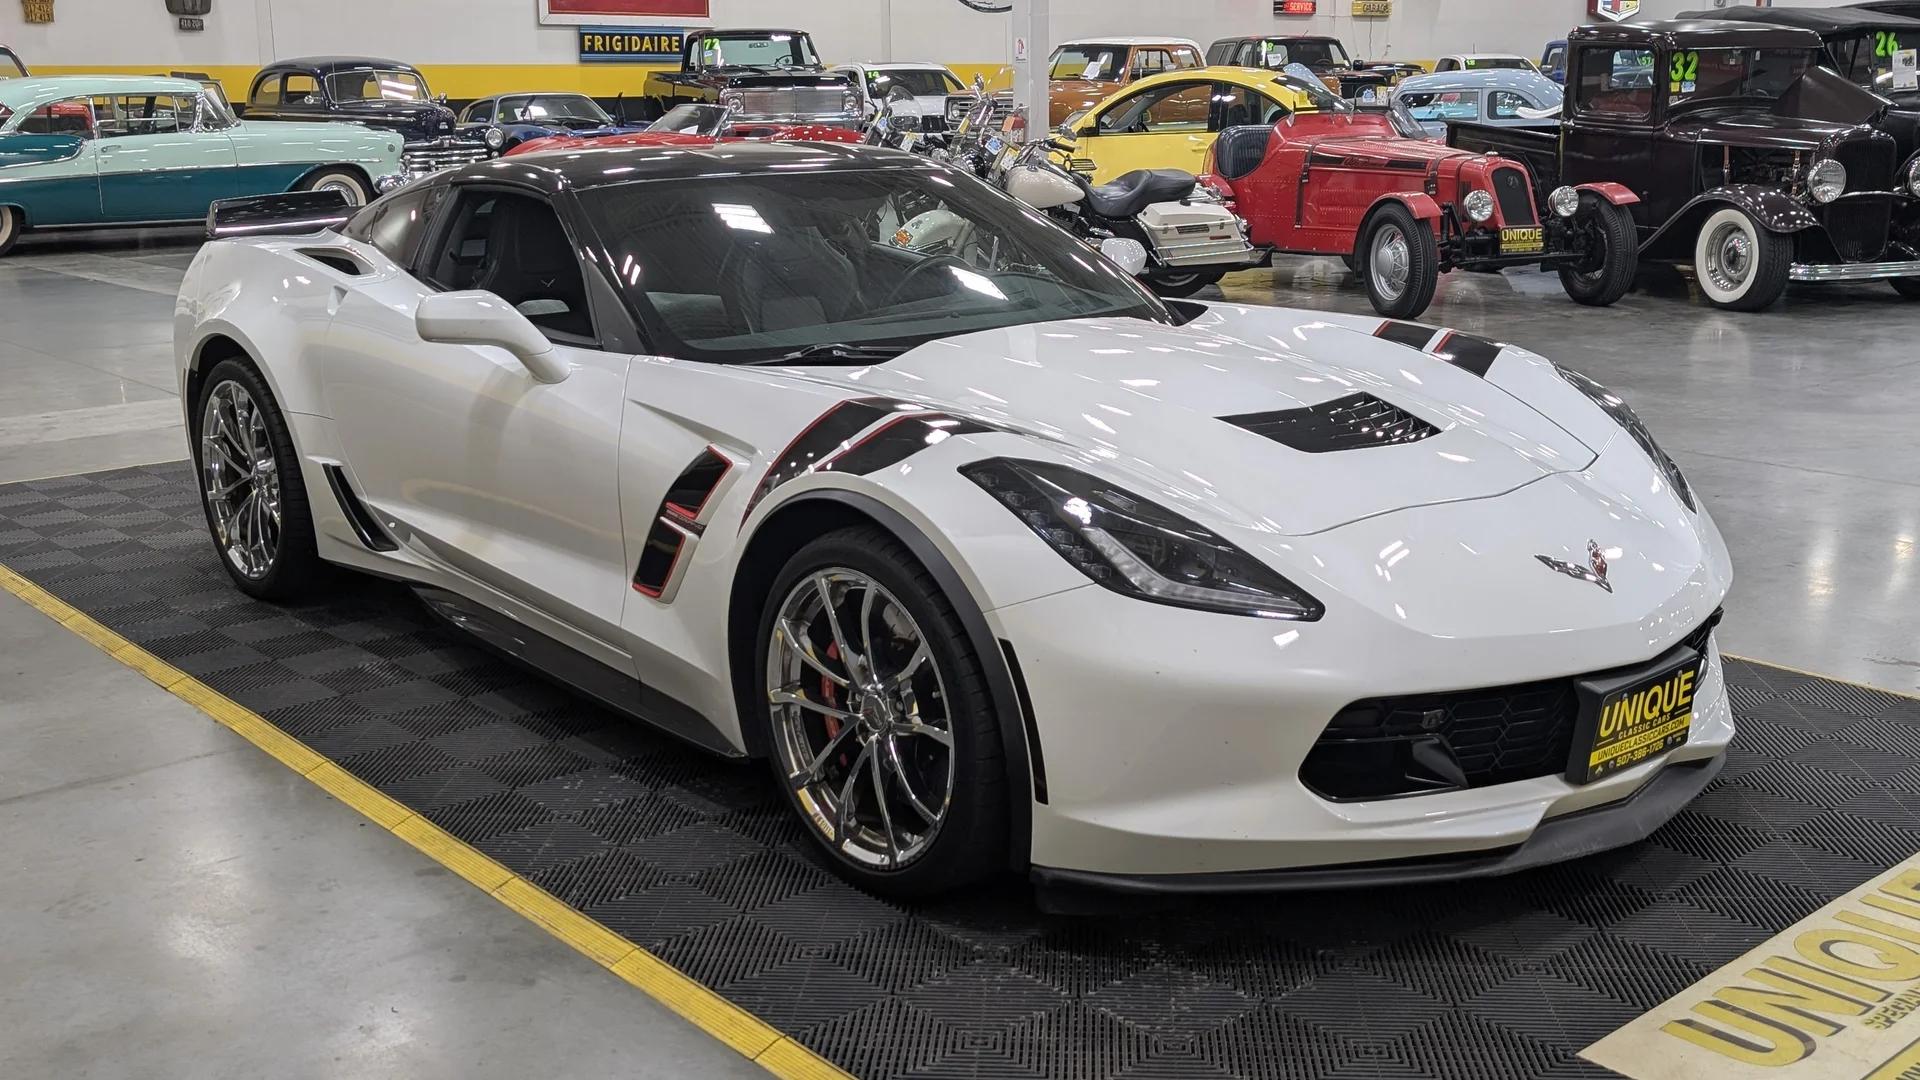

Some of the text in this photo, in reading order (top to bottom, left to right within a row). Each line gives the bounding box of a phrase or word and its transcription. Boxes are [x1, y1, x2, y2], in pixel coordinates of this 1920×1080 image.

[584, 35, 680, 52] FRIGIDAIRE
[1875, 31, 1898, 57] 26
[1671, 51, 1698, 81] 32
[1501, 228, 1543, 241] UNIQUE
[1600, 671, 1694, 737] UNIQUE
[1597, 717, 1685, 760] UNIQUECLASSICCARS.COM
[1618, 712, 1671, 739] CLASSIC CARS
